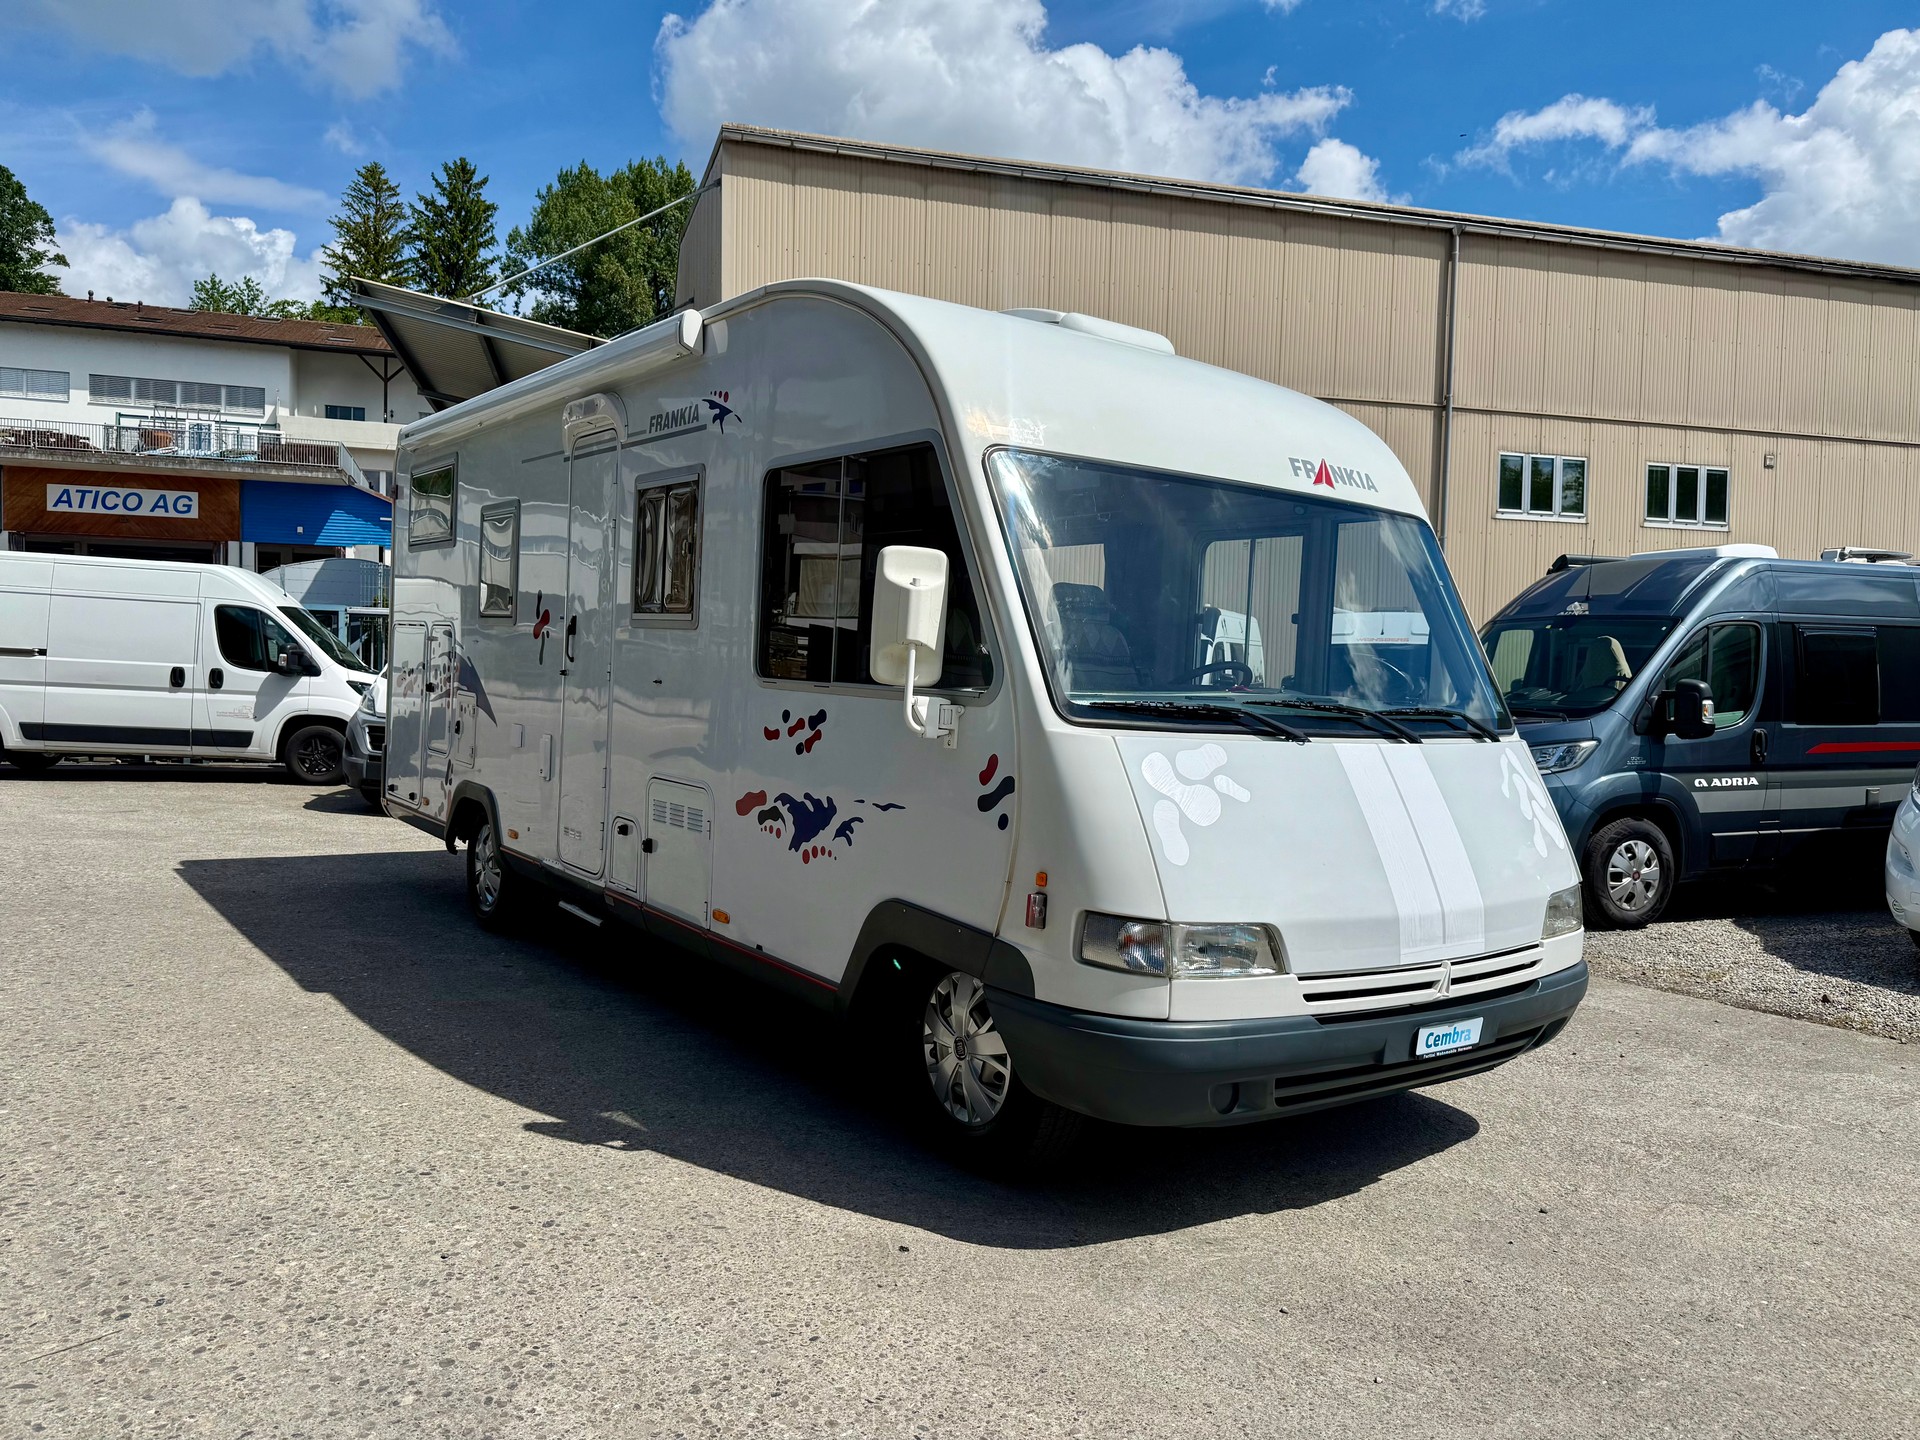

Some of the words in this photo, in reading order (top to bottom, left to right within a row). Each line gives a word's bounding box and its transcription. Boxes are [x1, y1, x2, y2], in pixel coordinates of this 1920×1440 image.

[648, 404, 700, 434] FRANKIA
[1287, 457, 1379, 493] FRANKIA
[52, 488, 144, 512] ATICO
[149, 494, 194, 514] AG
[1710, 776, 1760, 787] ADRIA
[1425, 1026, 1472, 1049] Cembra
